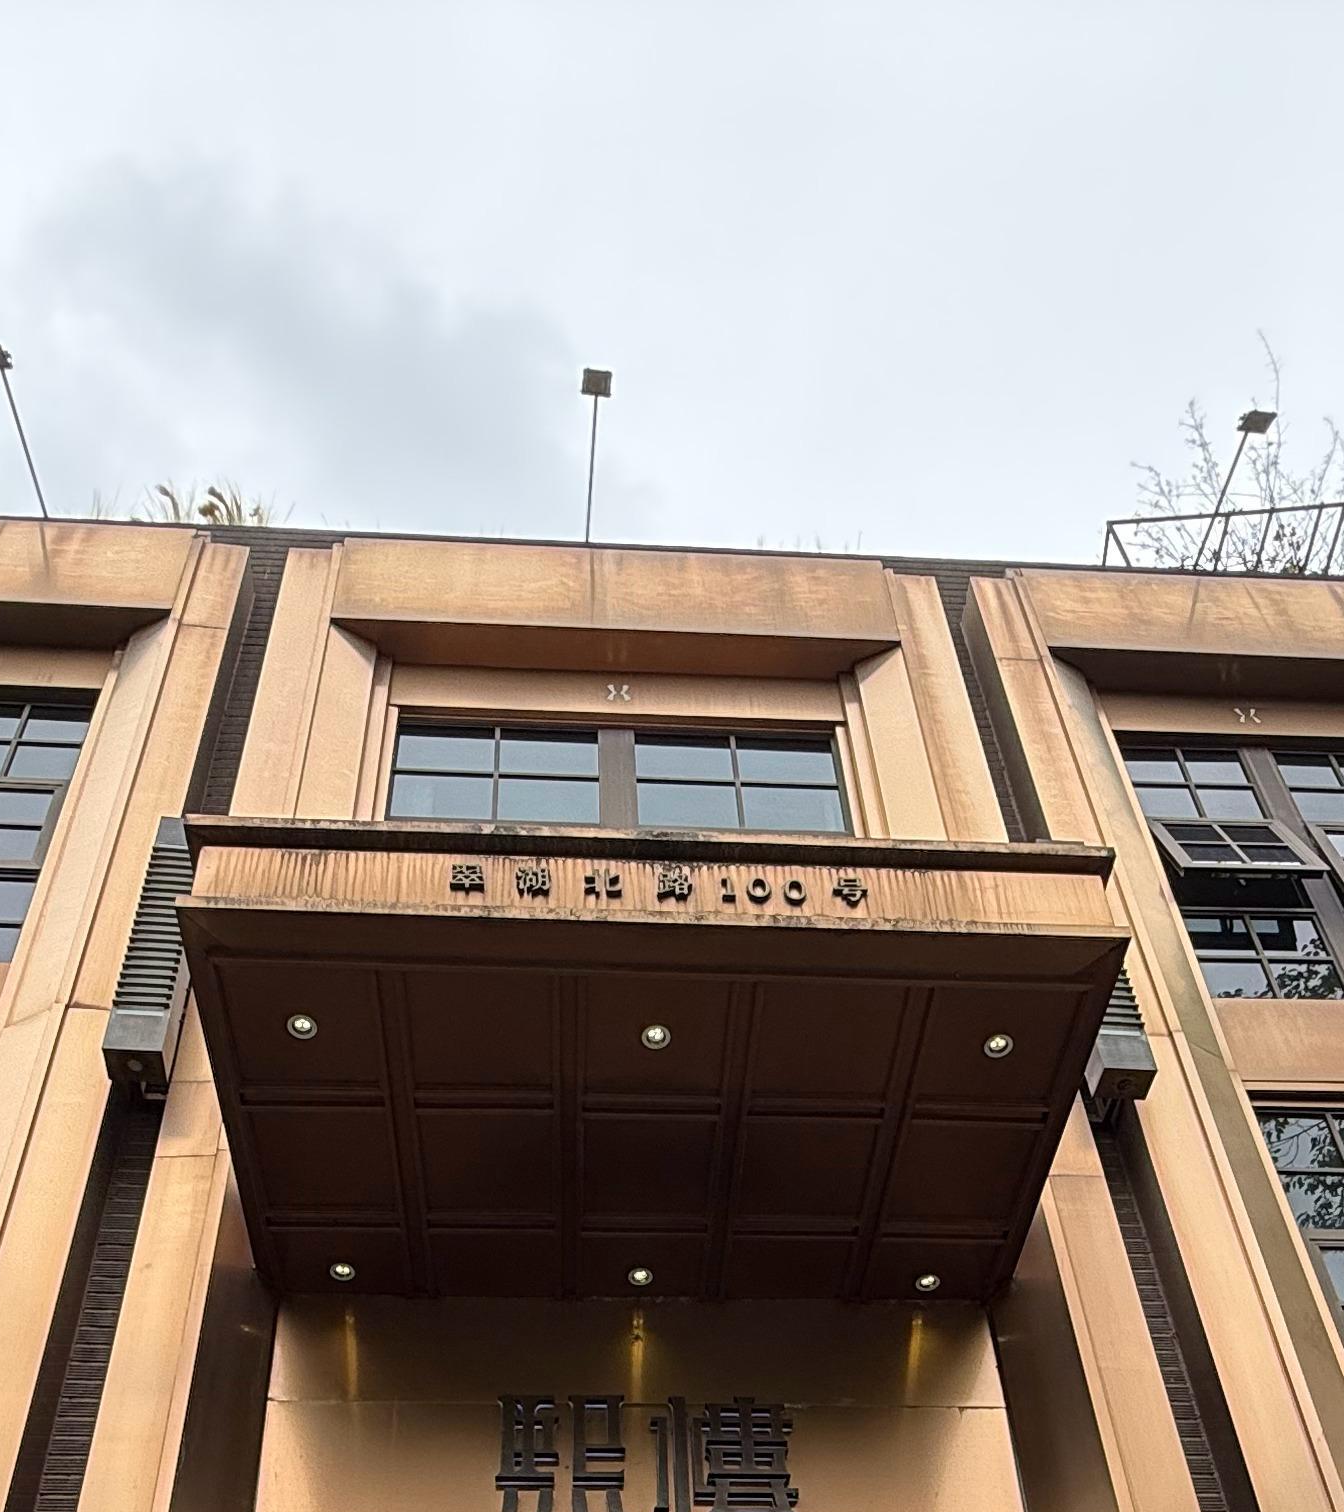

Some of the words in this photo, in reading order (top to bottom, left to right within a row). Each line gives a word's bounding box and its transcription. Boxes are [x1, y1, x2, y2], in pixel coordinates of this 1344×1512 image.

[450, 863, 869, 908] 翠湖北路100号
